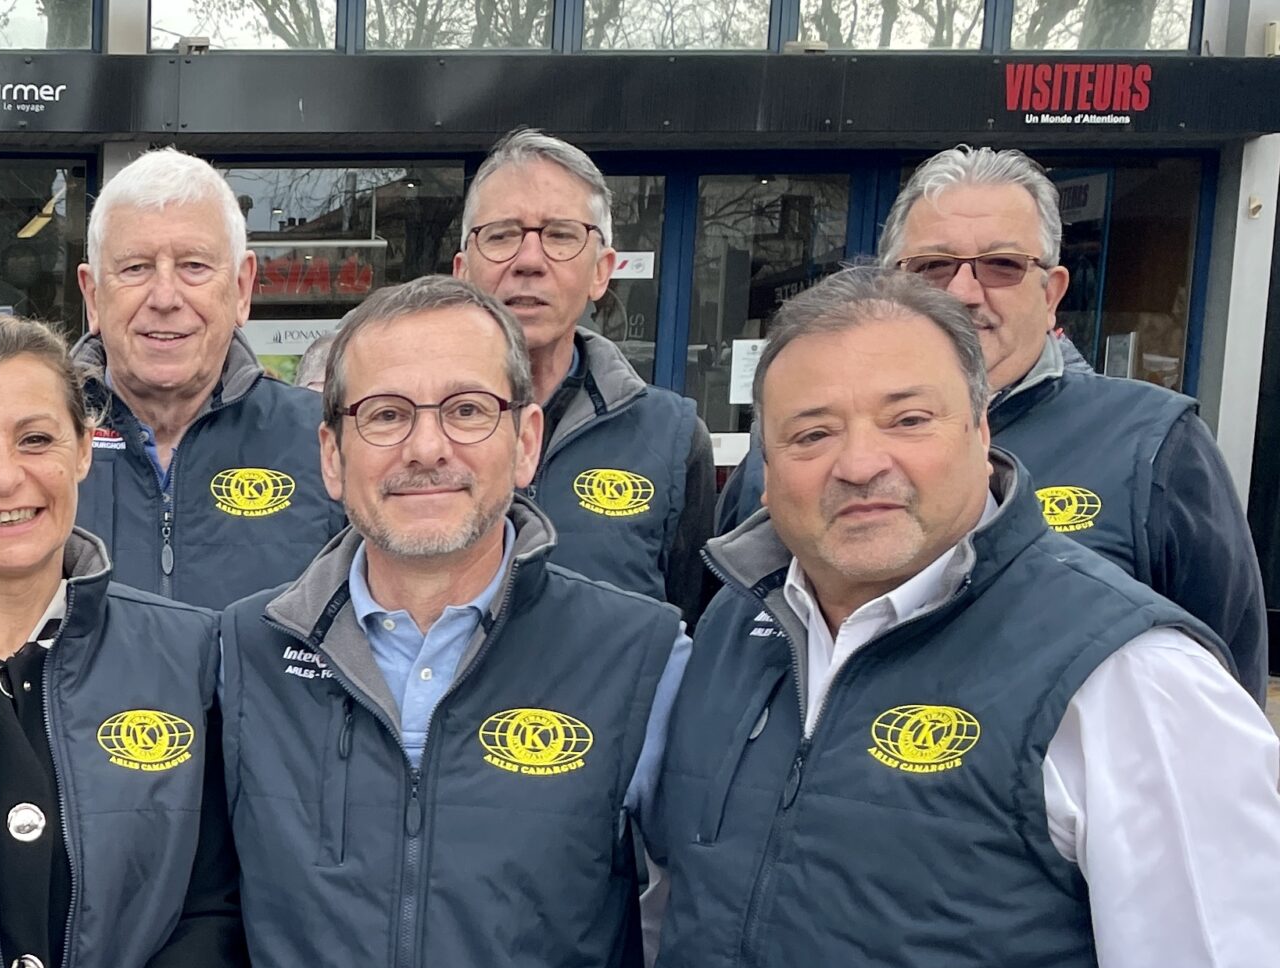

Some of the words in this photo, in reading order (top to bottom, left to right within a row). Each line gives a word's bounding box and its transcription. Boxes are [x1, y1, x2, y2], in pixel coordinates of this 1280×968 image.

[1005, 63, 1153, 111] VISITEURS
[3, 101, 13, 111] le
[16, 103, 45, 112] voyage
[1025, 113, 1039, 124] Un
[1040, 113, 1072, 124] Monde
[1074, 113, 1131, 124] d'Attentions
[133, 725, 157, 747] K
[523, 725, 550, 749] K
[483, 753, 519, 773] ARLES
[520, 758, 586, 775] CAMARGUE
[867, 746, 900, 768] ARLES
[899, 757, 963, 773] CAMARGUE
